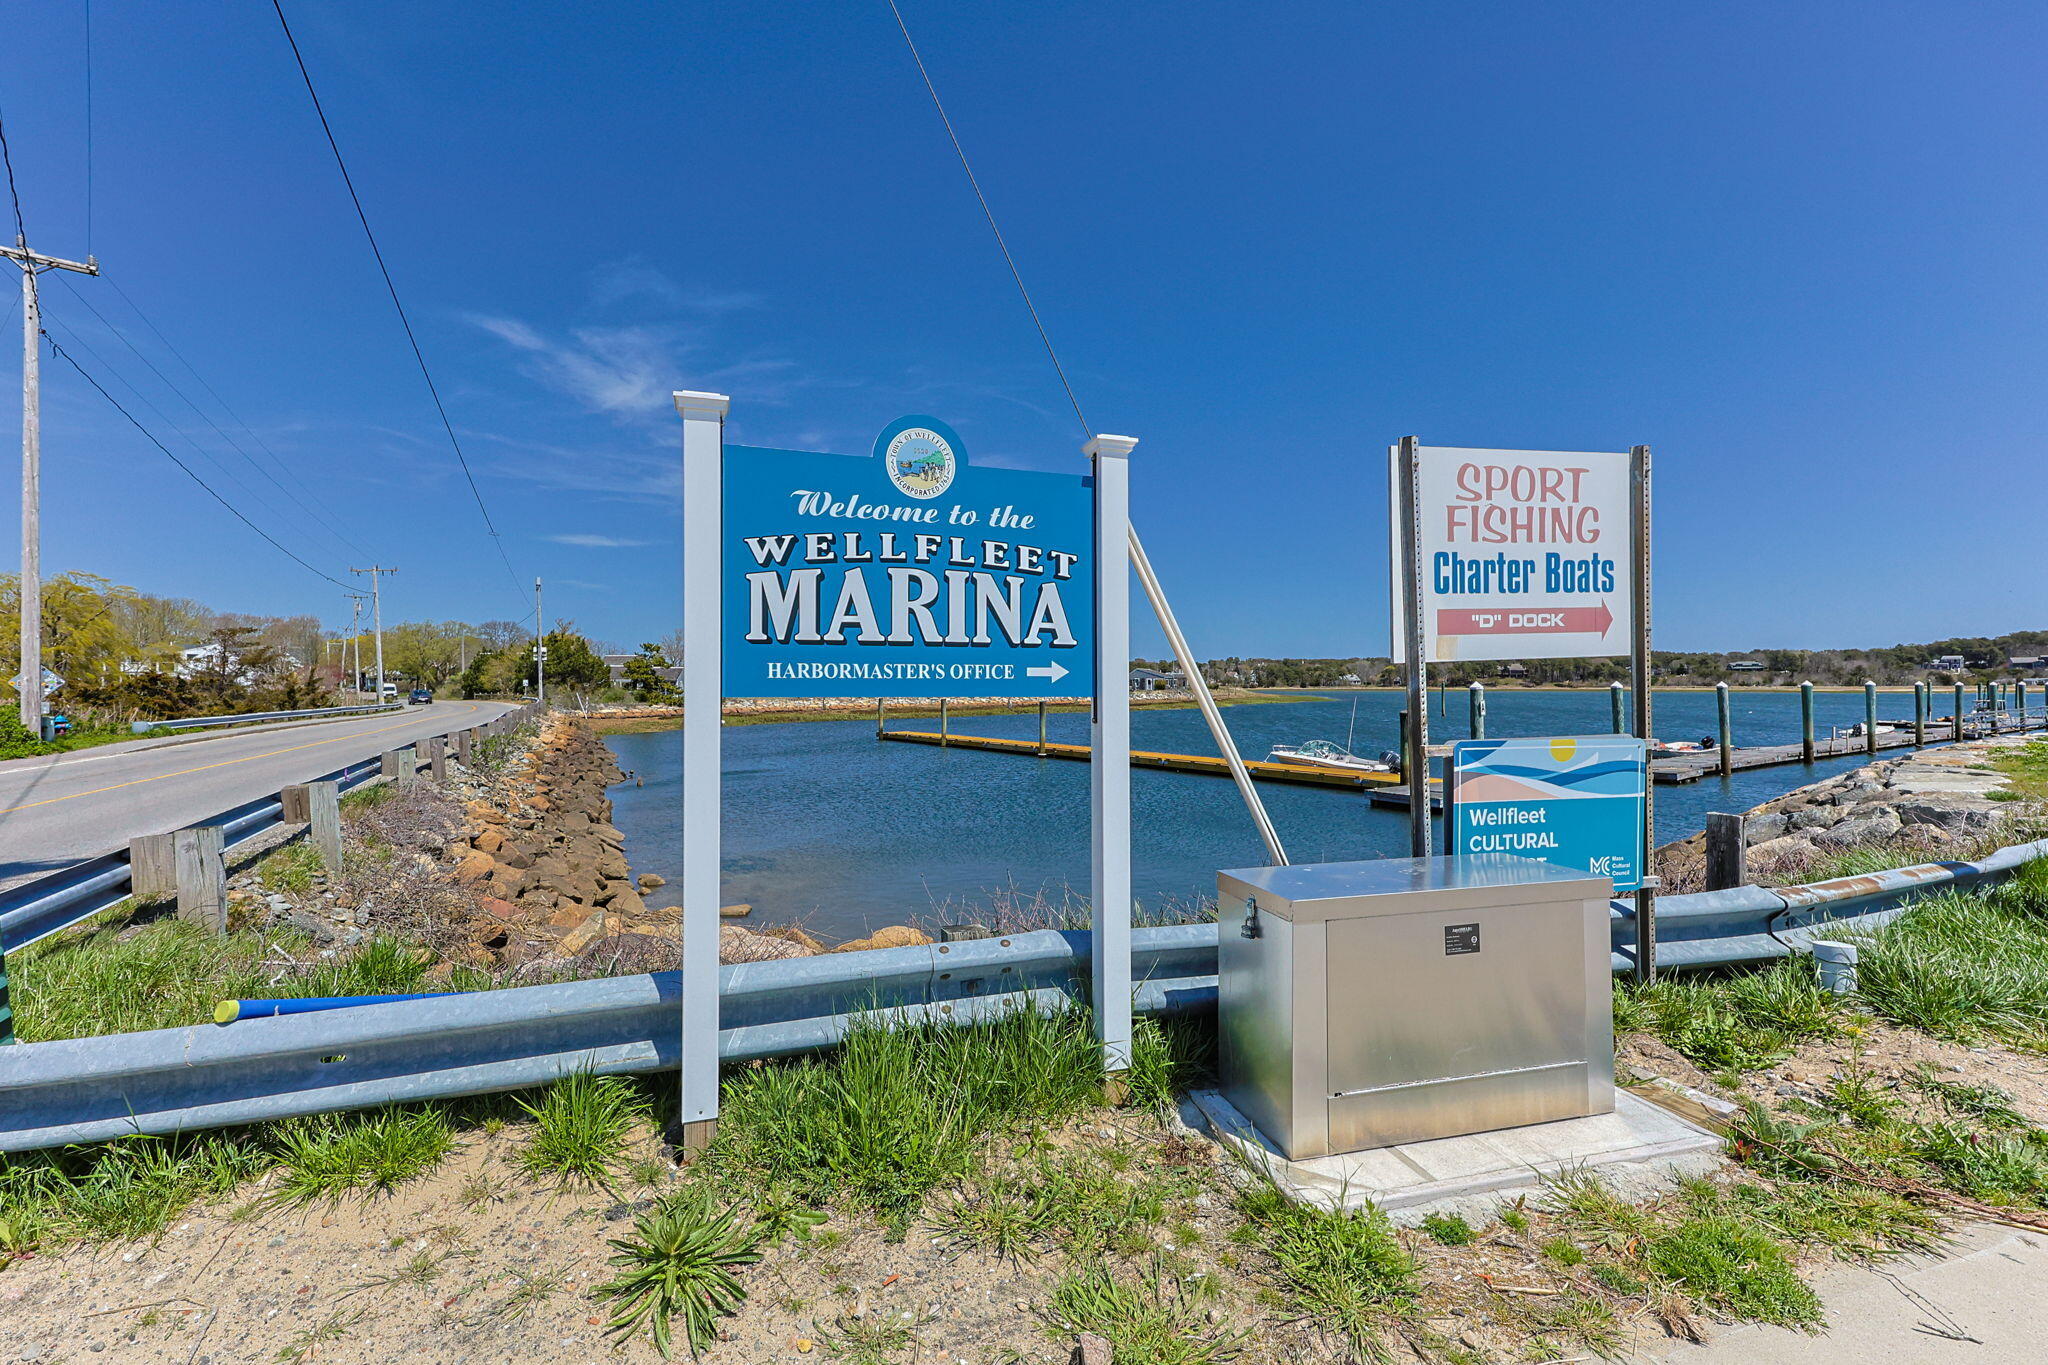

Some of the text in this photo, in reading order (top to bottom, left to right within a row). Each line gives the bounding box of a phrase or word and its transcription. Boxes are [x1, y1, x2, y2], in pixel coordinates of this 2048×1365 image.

[893, 473, 940, 496] INCORPORATED
[1456, 462, 1590, 503] SPORT
[790, 490, 1036, 530] Welcome to the
[1446, 504, 1601, 544] FISHING
[744, 532, 1079, 580] WELLFLEET
[1434, 551, 1615, 594] Charter Boats
[745, 567, 1078, 648] MARINA
[1471, 613, 1565, 628] "D" DOCK
[767, 662, 1015, 681] HARBORMASTER'S OFFICE
[1469, 807, 1547, 827] Wellfleet
[1469, 832, 1559, 852] CULTURAL
